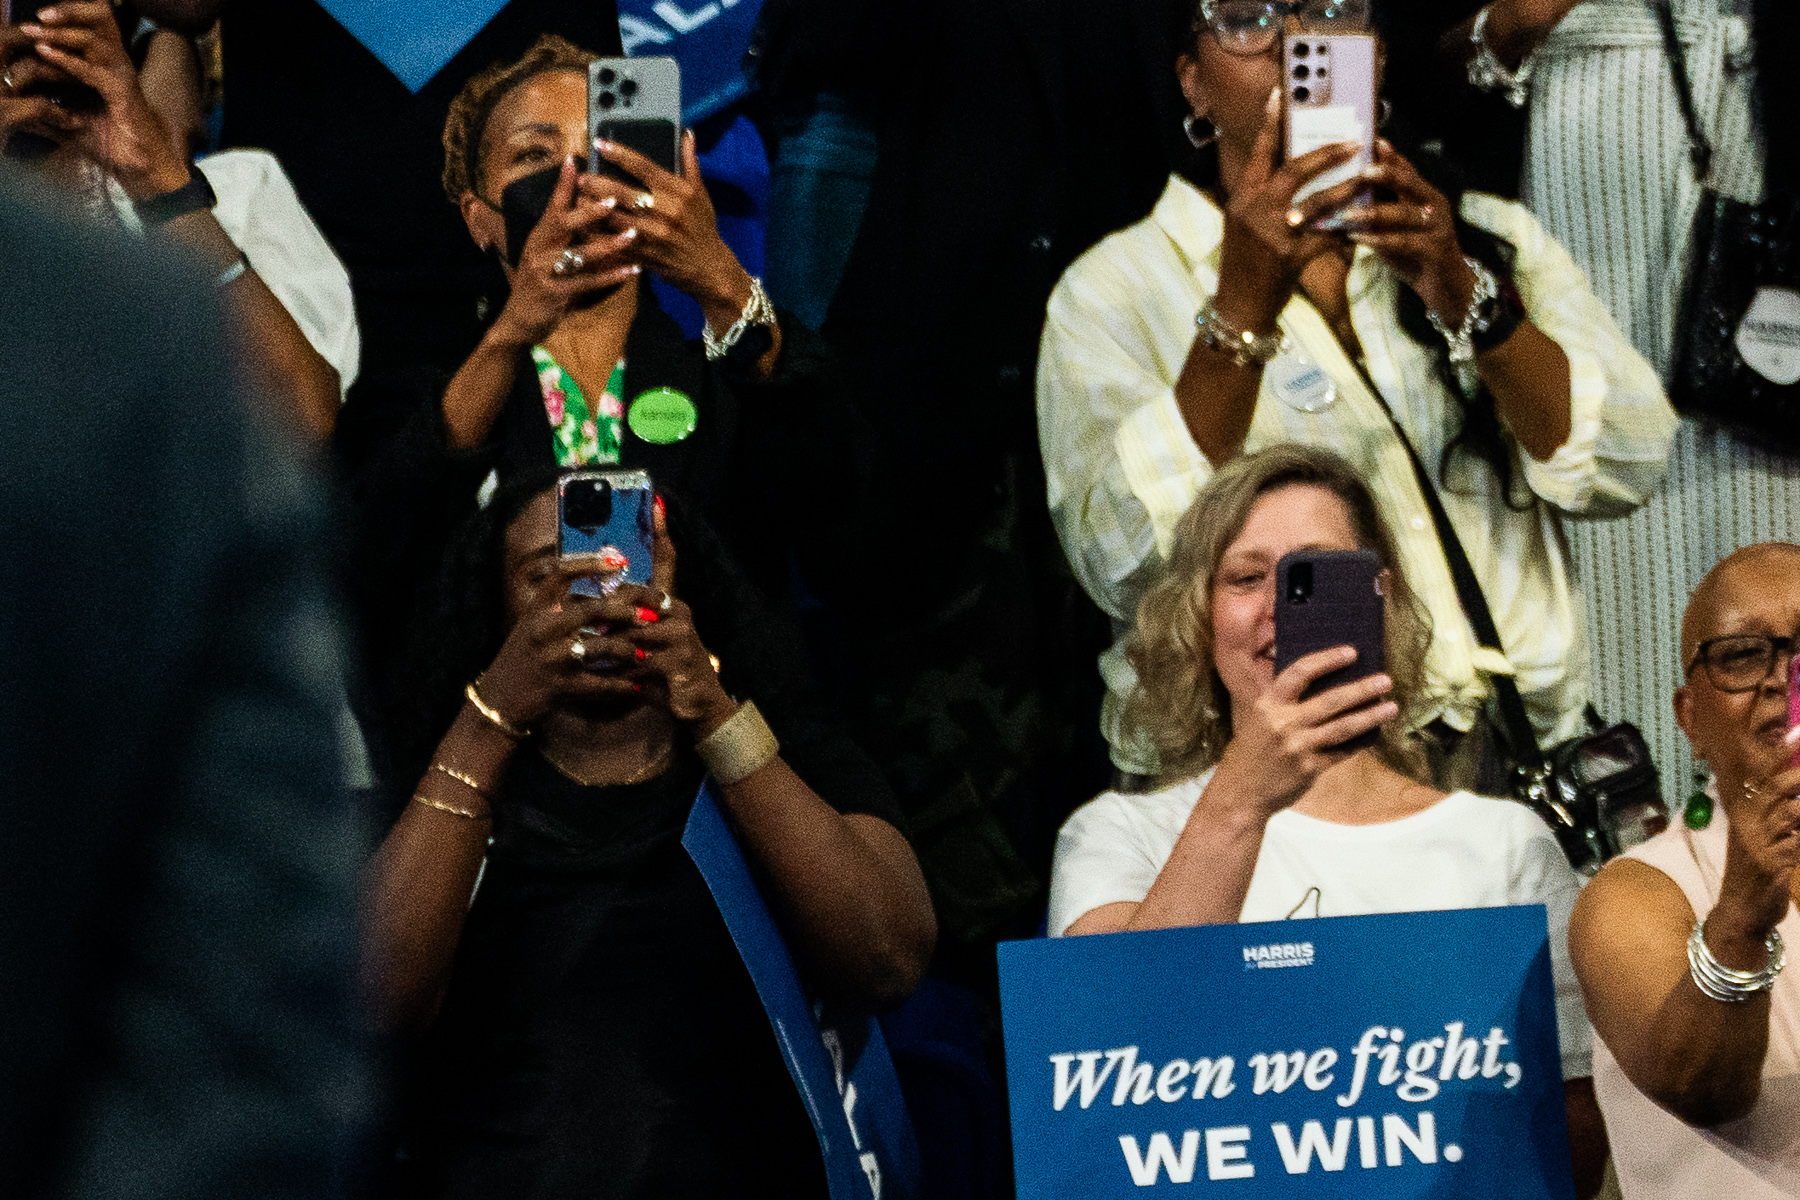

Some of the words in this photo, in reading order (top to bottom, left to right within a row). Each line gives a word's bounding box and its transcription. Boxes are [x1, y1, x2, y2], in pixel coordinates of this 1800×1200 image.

[1242, 941, 1315, 962] HARRIS
[1257, 957, 1315, 969] PRESIDENT
[1049, 1045, 1236, 1111] When
[1248, 1048, 1339, 1097] we
[1336, 1021, 1523, 1108] fight,
[1119, 1126, 1255, 1187] WE
[1271, 1111, 1463, 1176] WIN.
